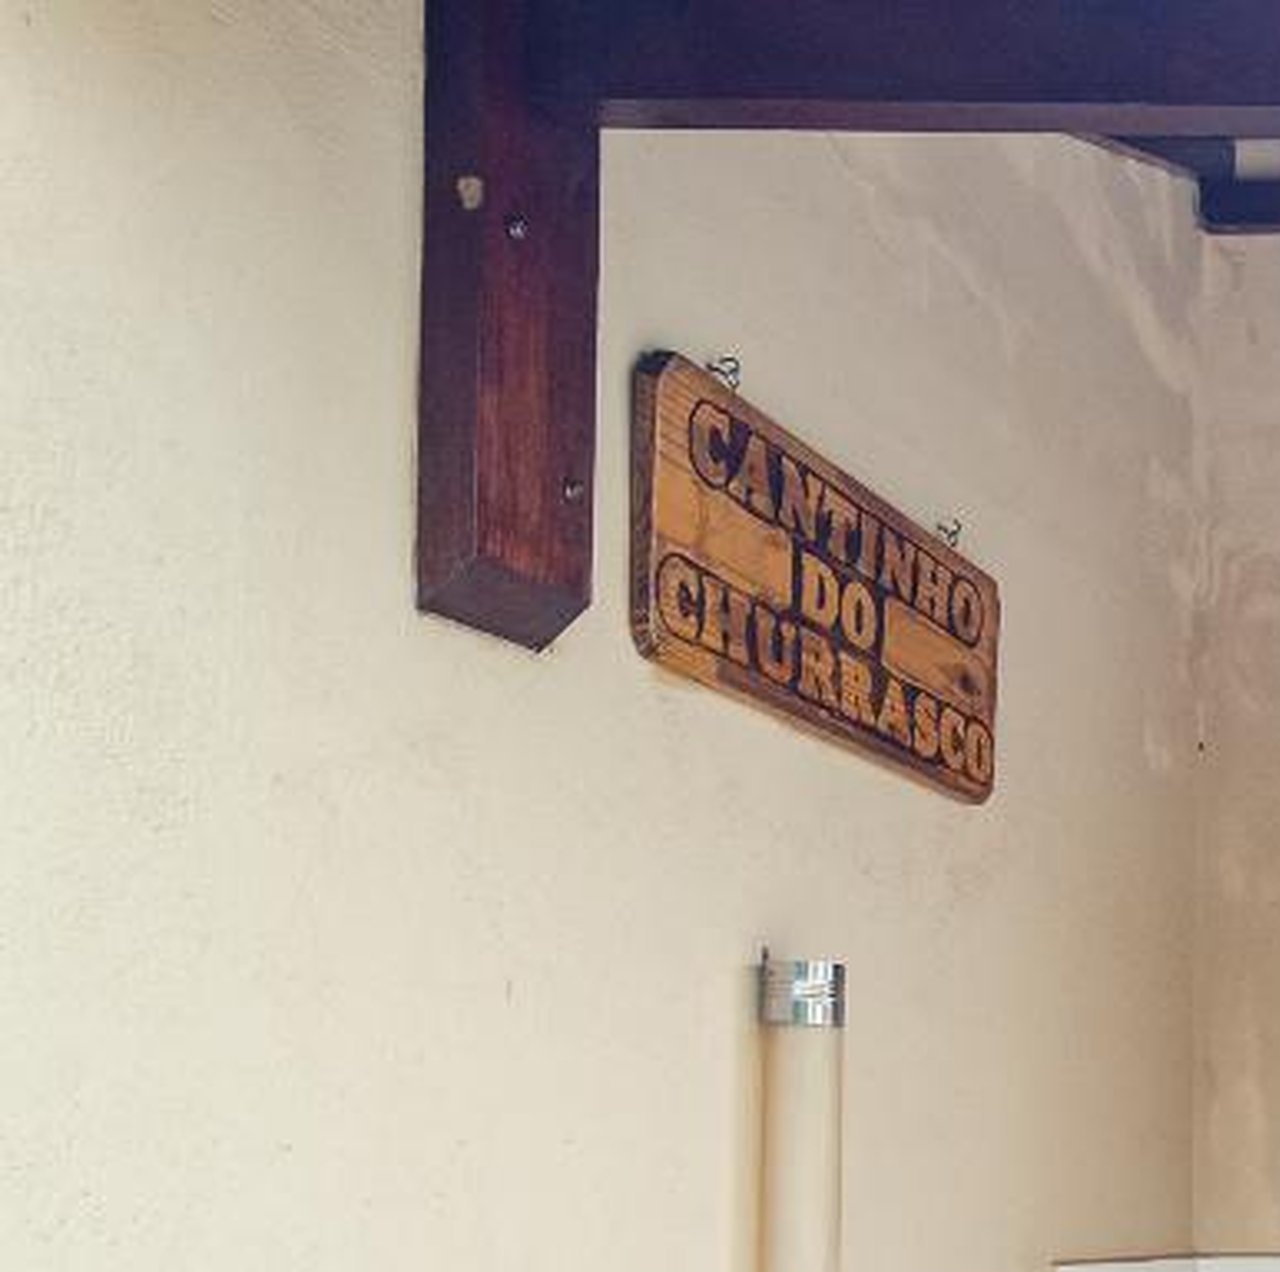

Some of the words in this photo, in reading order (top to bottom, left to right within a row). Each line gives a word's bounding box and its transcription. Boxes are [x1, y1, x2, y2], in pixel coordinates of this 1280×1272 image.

[688, 400, 984, 648] CANTINHO
[798, 549, 877, 653] DO
[656, 553, 993, 785] CHURRASCO
